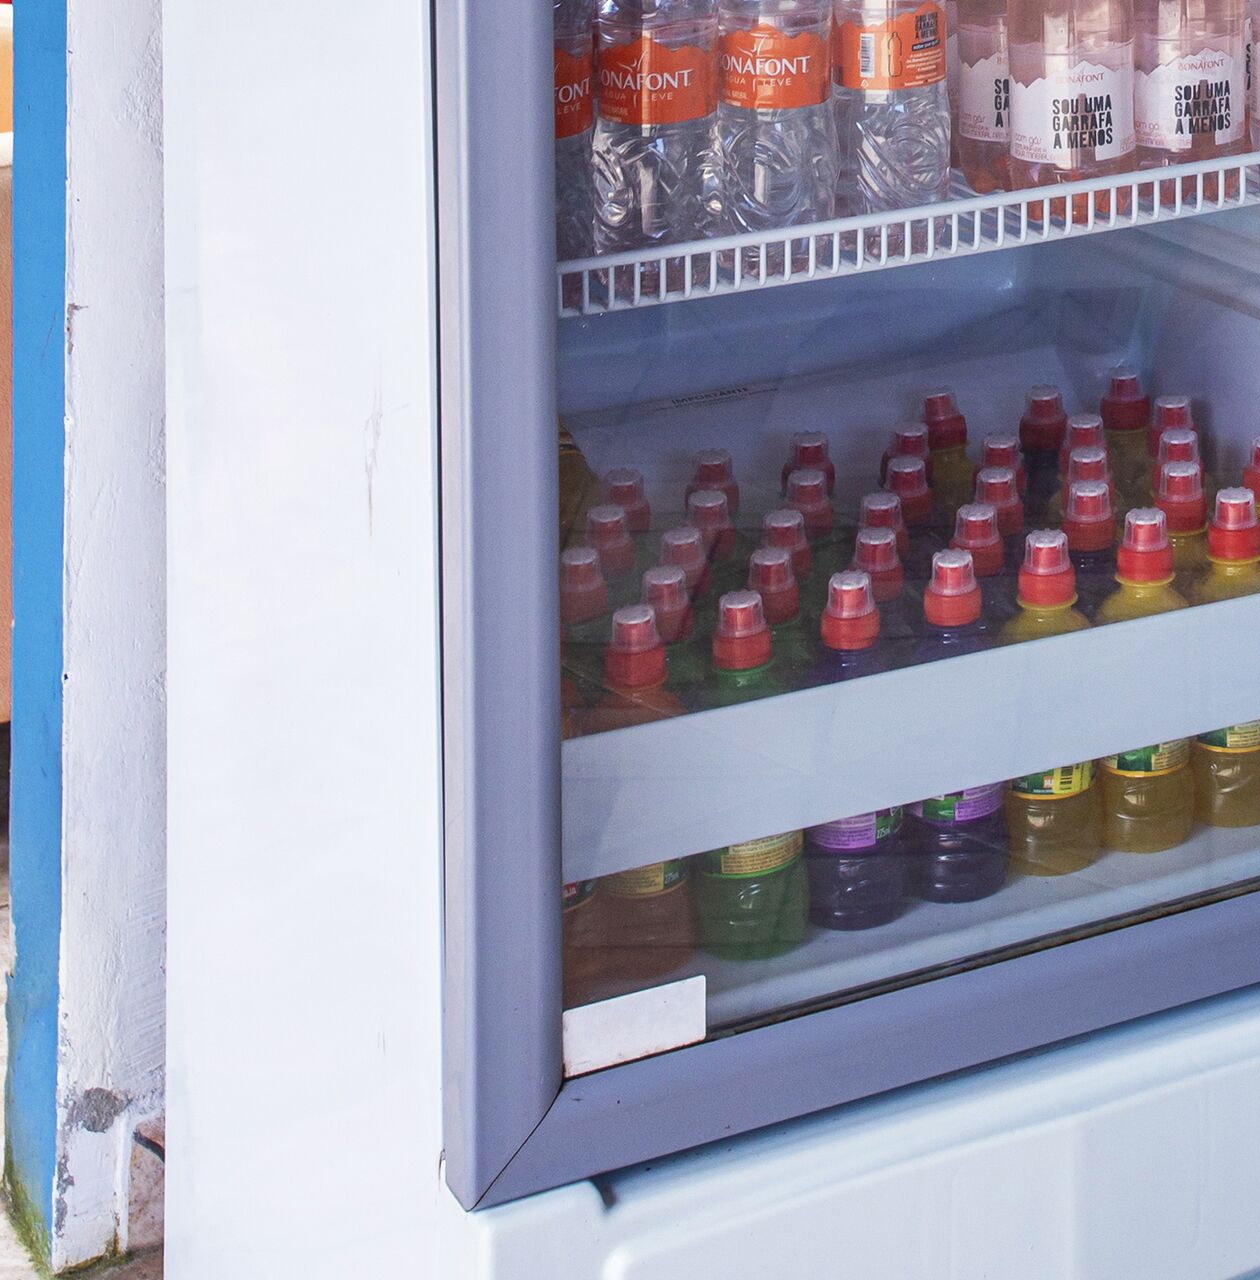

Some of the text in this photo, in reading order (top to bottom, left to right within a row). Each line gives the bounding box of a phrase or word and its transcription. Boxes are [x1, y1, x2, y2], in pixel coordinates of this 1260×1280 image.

[721, 54, 811, 77] ONAFONT
[1178, 58, 1224, 72] BONAFONT
[601, 68, 694, 92] ONAFONT
[762, 77, 793, 88] LEVE
[1174, 79, 1231, 101] SOU UMA
[556, 102, 582, 116] LEVE
[1052, 94, 1113, 116] SOU UMA
[1174, 96, 1231, 117] GARRAFA
[1052, 111, 1113, 132] GARRAFA
[1175, 118, 1184, 134] A
[1188, 112, 1231, 134] MENOS
[1053, 133, 1062, 149] A
[1066, 127, 1114, 149] MENOS
